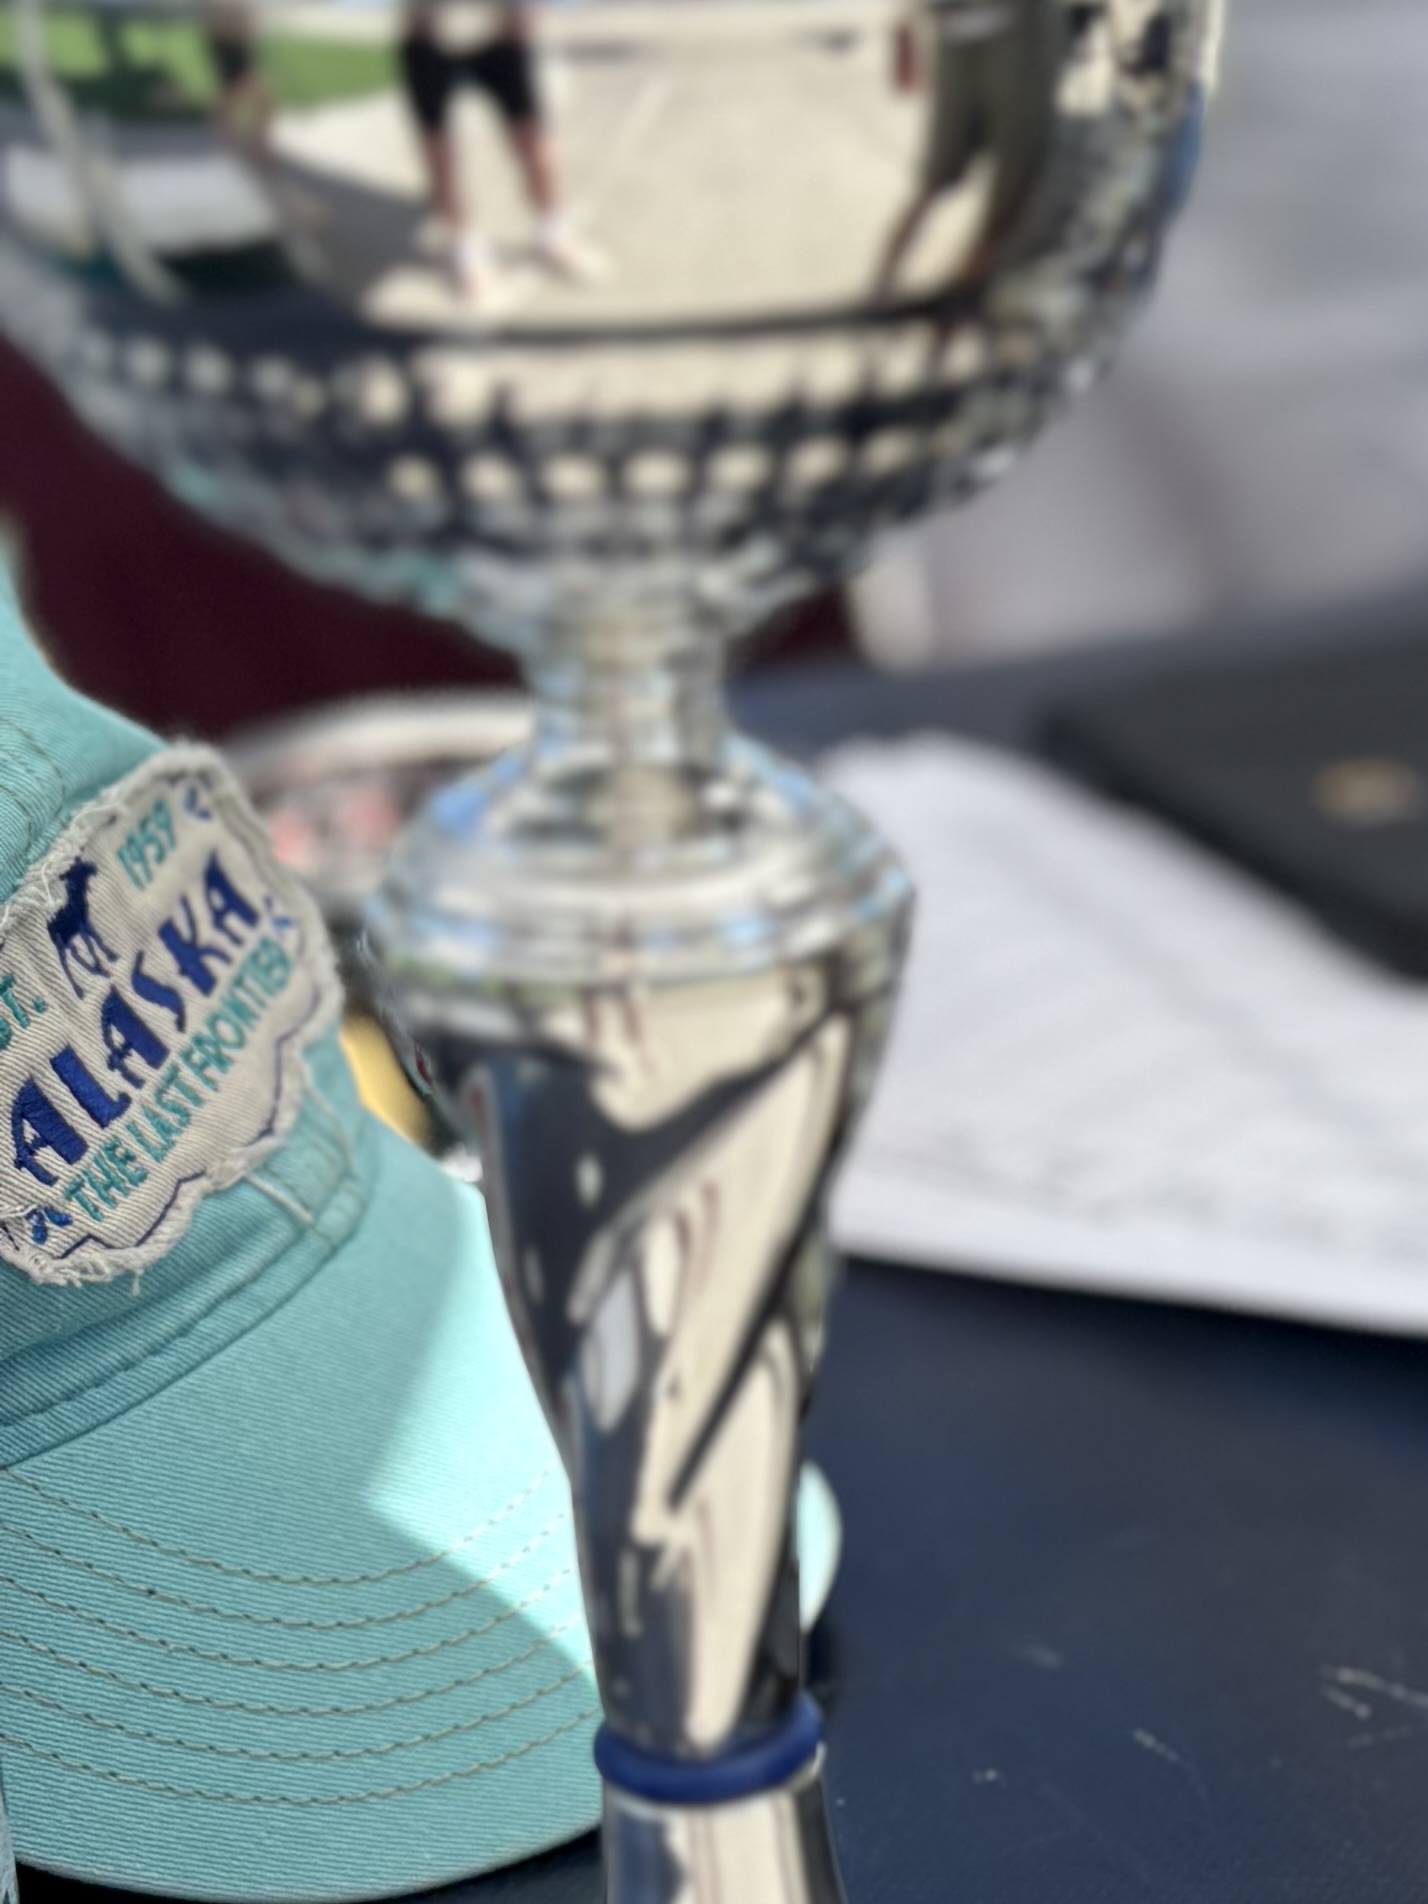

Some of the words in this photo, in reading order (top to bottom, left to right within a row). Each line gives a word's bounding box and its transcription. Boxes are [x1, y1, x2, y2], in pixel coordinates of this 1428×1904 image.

[117, 798, 177, 891] 1959
[11, 848, 262, 1186] ALASKA
[63, 1134, 148, 1221] THE
[125, 1063, 204, 1164] LAST
[181, 937, 293, 1092] FRONTIER
